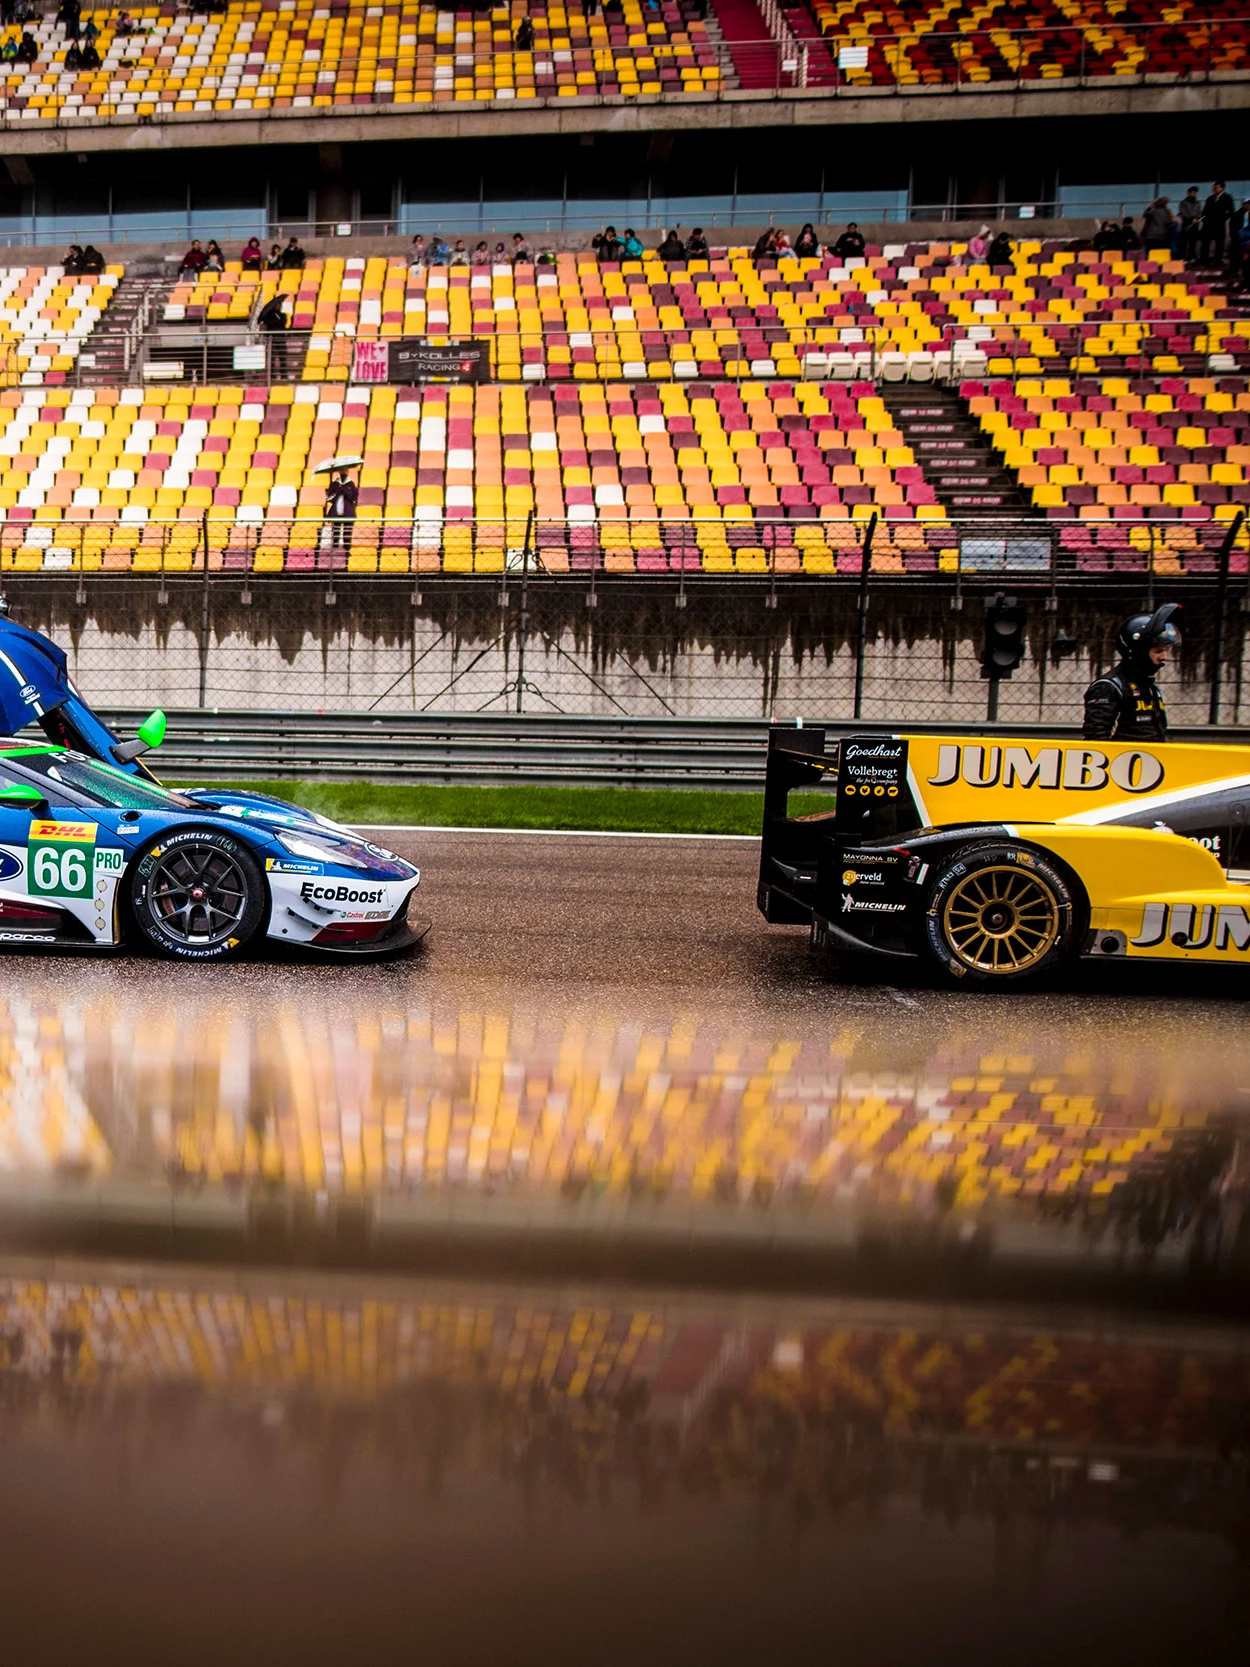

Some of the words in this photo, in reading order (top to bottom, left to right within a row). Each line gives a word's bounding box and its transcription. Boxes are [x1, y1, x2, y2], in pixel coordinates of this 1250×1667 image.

[355, 342, 377, 360] WE
[354, 361, 386, 379] LOVE
[418, 363, 460, 372] RACING
[846, 744, 902, 760] Goedhart
[848, 766, 898, 778] Vollebregt
[927, 744, 1165, 793] JUMBO
[39, 825, 86, 837] DHL
[167, 833, 213, 846] MICHELIN
[95, 852, 122, 869] PRO
[283, 863, 319, 871] MICHELIN
[34, 847, 86, 891] 66
[1038, 864, 1069, 898] MICHELIN
[300, 882, 384, 903] EcoBoost
[854, 902, 906, 910] MICHELIN
[176, 945, 222, 957] MICHELIN
